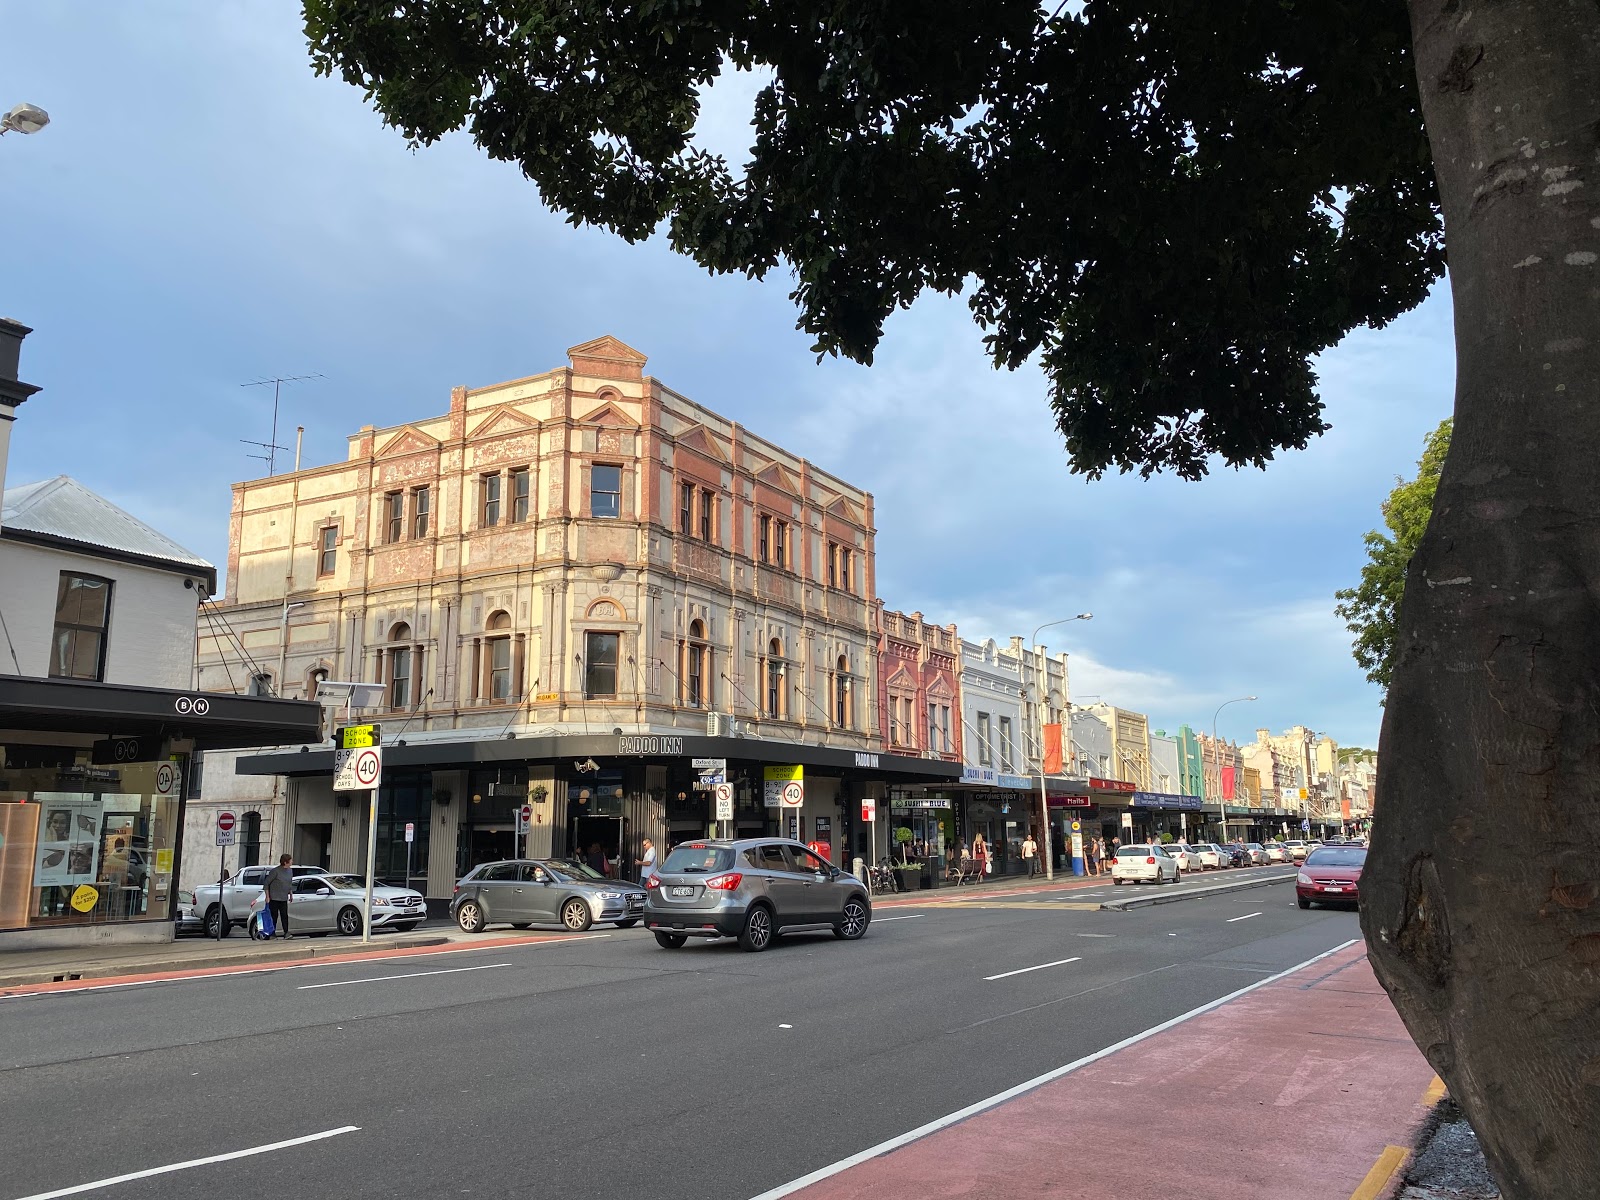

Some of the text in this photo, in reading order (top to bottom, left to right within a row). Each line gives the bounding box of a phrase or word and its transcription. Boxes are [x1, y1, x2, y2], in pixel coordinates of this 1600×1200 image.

[619, 736, 683, 754] PADDO INN
[360, 760, 376, 775] 40
[855, 752, 870, 768] PADDO
[967, 768, 980, 779] SUSHI
[983, 770, 993, 781] BLUE
[786, 788, 800, 799] 40
